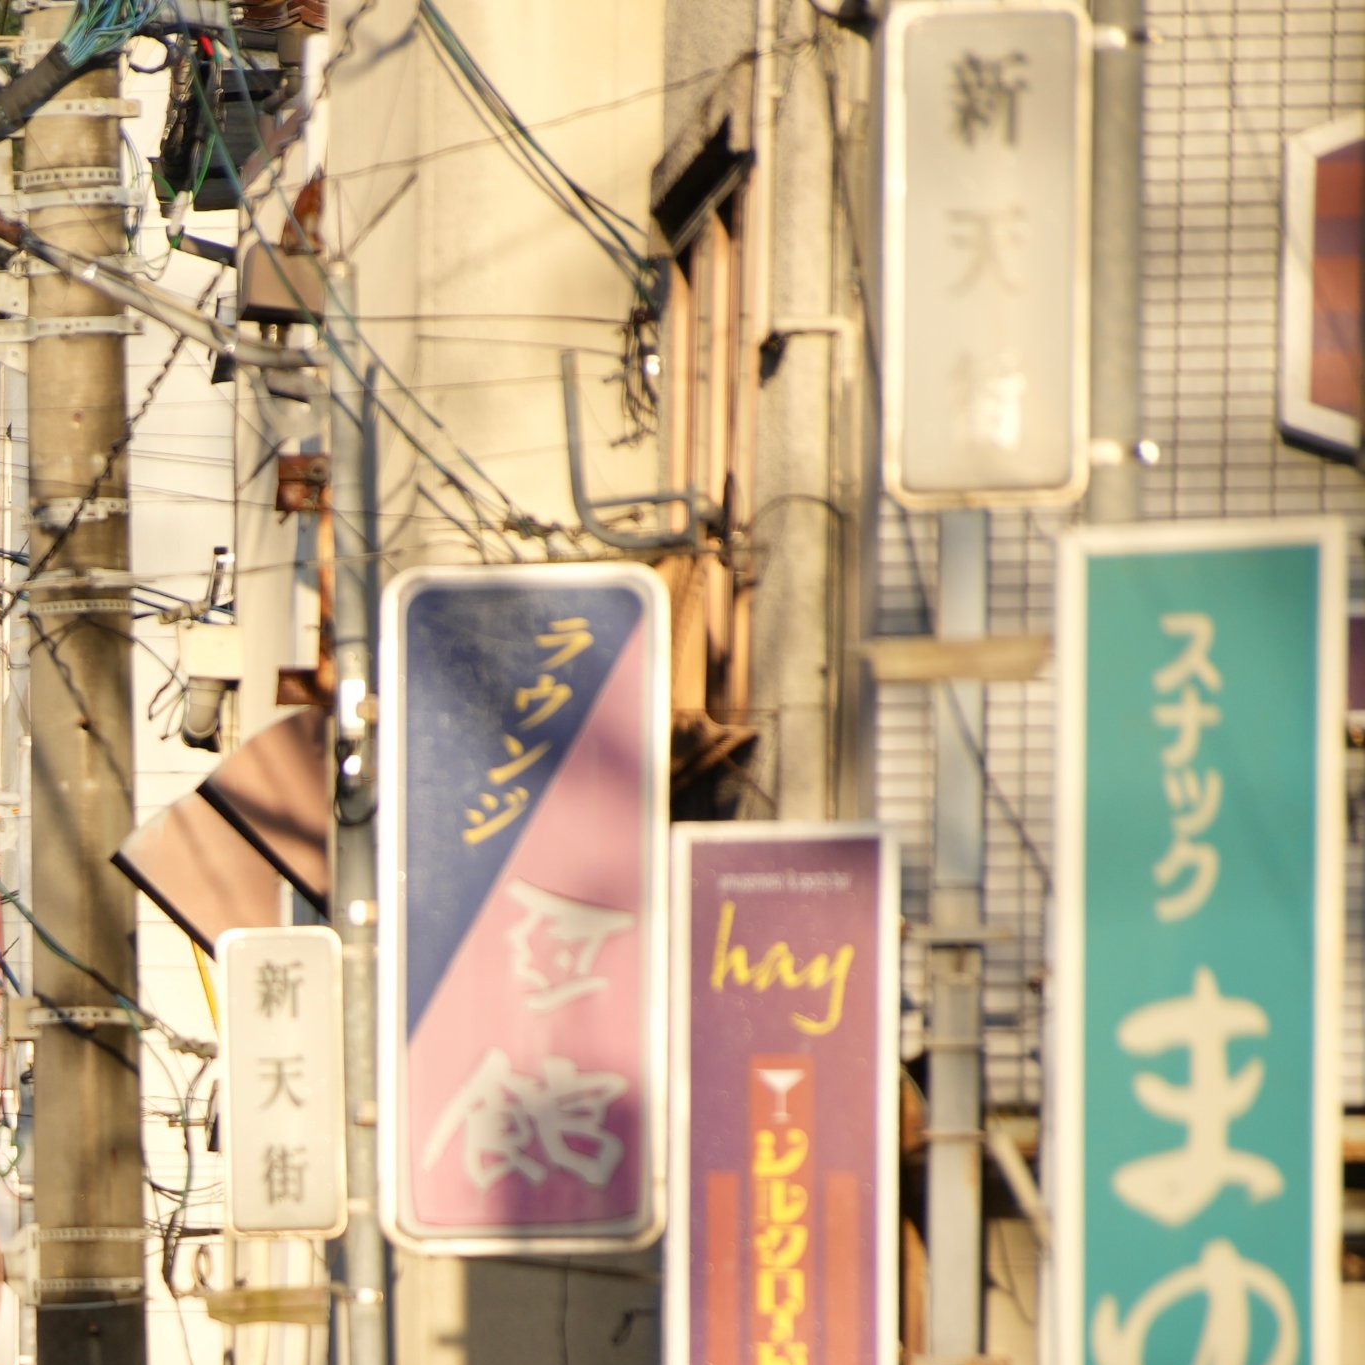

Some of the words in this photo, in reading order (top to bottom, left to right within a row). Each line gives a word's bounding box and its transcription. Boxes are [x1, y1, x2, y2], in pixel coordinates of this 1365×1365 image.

[463, 617, 595, 845] ラウンジ
[1152, 612, 1222, 922] スナック
[255, 959, 307, 1205] 新天街
[711, 900, 855, 1034] hay
